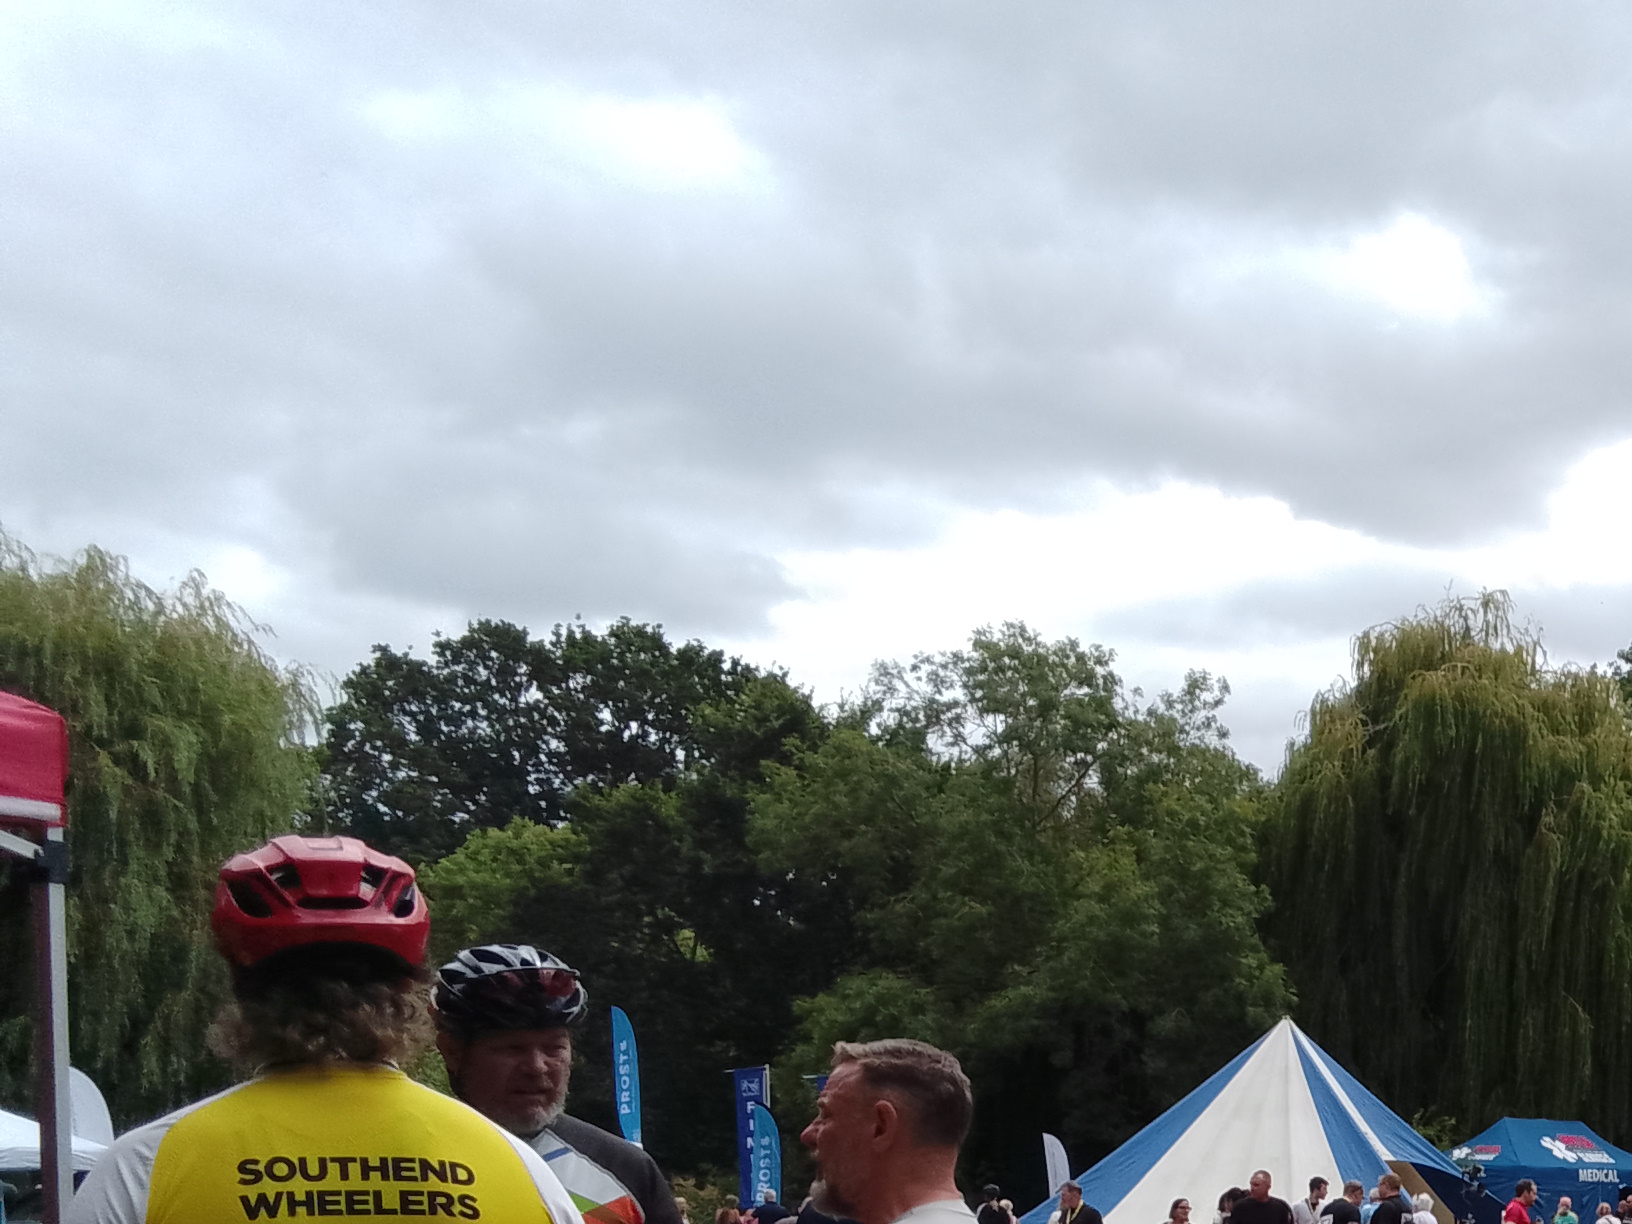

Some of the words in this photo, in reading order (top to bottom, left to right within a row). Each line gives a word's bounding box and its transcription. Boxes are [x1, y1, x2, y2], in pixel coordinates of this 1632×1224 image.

[237, 1156, 476, 1186] SOUTHEND
[1578, 1168, 1620, 1183] MEDICAL
[239, 1189, 482, 1221] WHEELERS
